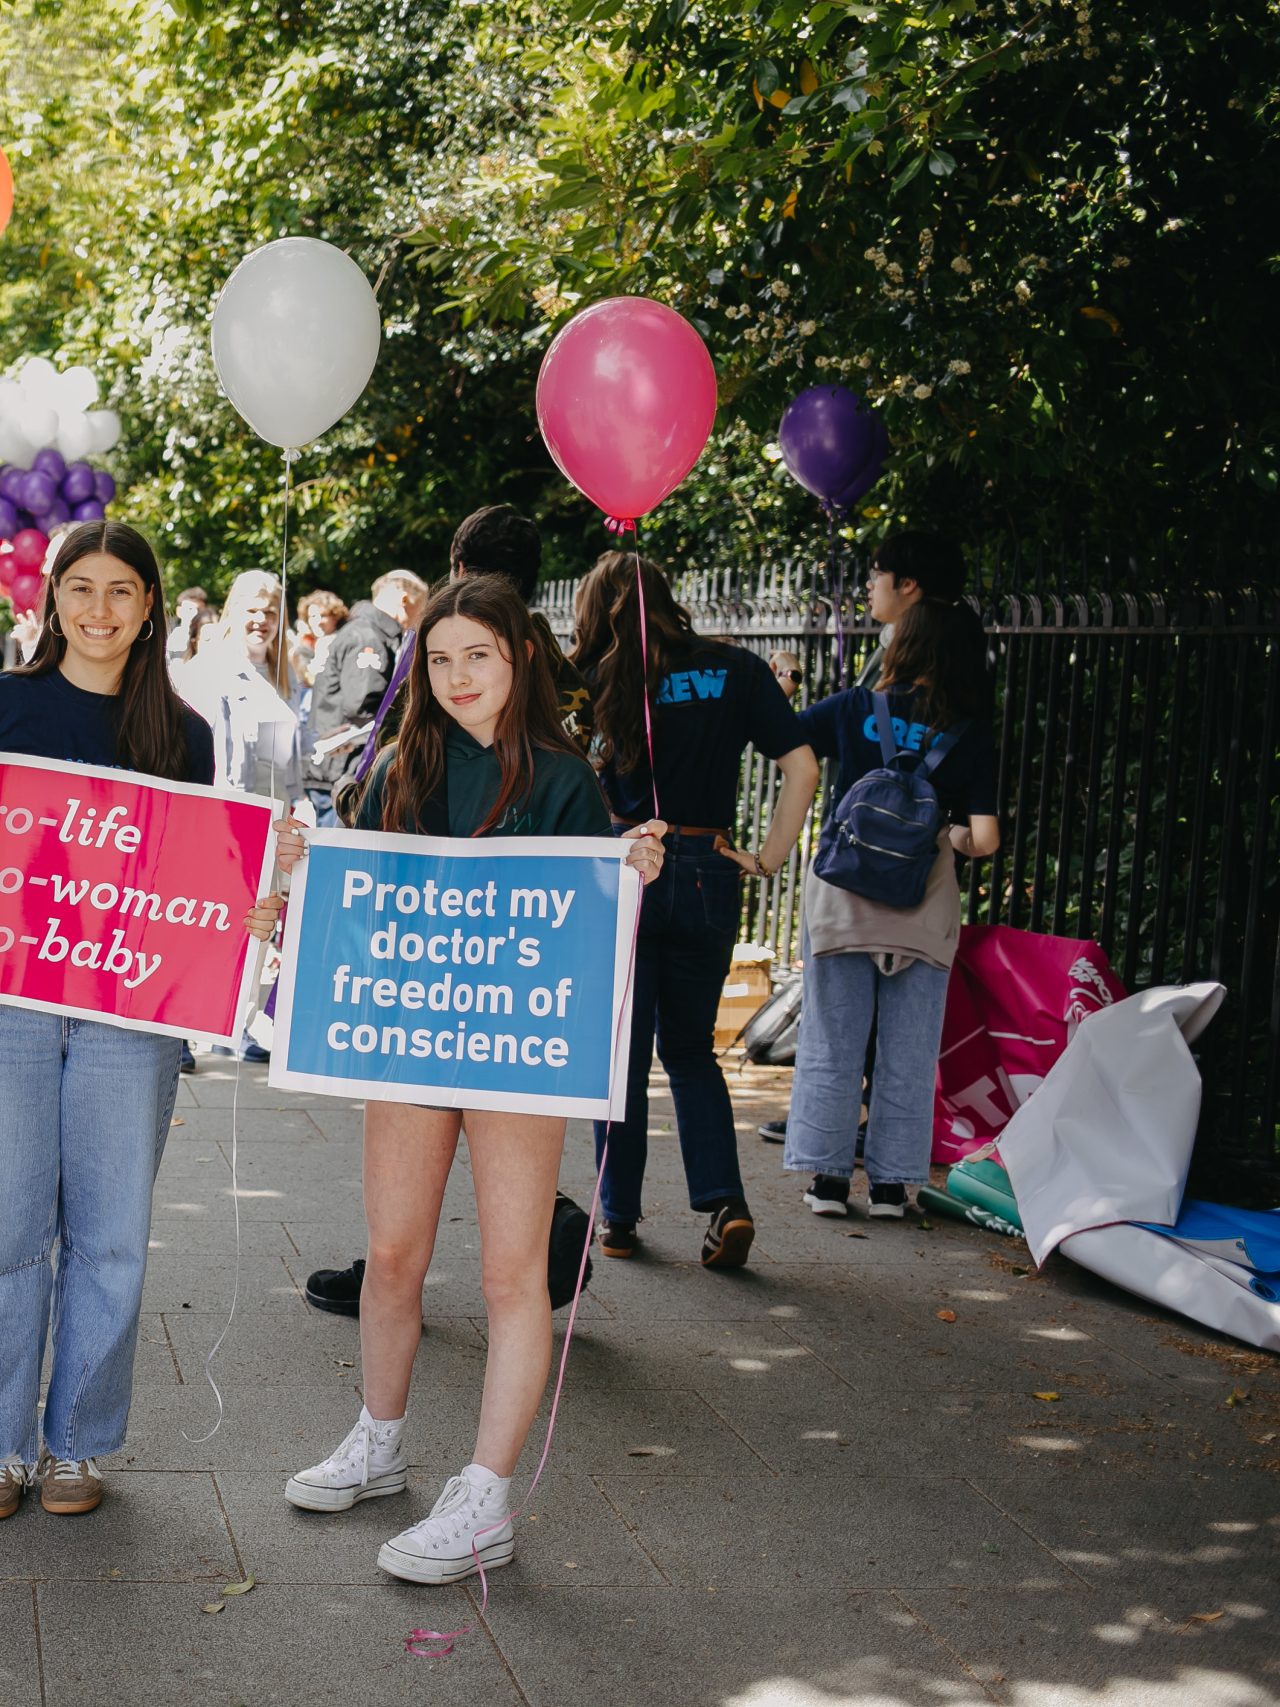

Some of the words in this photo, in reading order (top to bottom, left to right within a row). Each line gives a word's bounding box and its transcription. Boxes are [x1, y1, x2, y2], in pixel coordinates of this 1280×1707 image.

[656, 669, 727, 704] REW
[863, 714, 944, 751] CRE
[342, 869, 498, 917] Protect
[509, 888, 576, 929] my
[370, 921, 541, 967] doctor's
[333, 964, 514, 1015] freedom
[528, 977, 573, 1018] of
[327, 1021, 570, 1069] conscience
